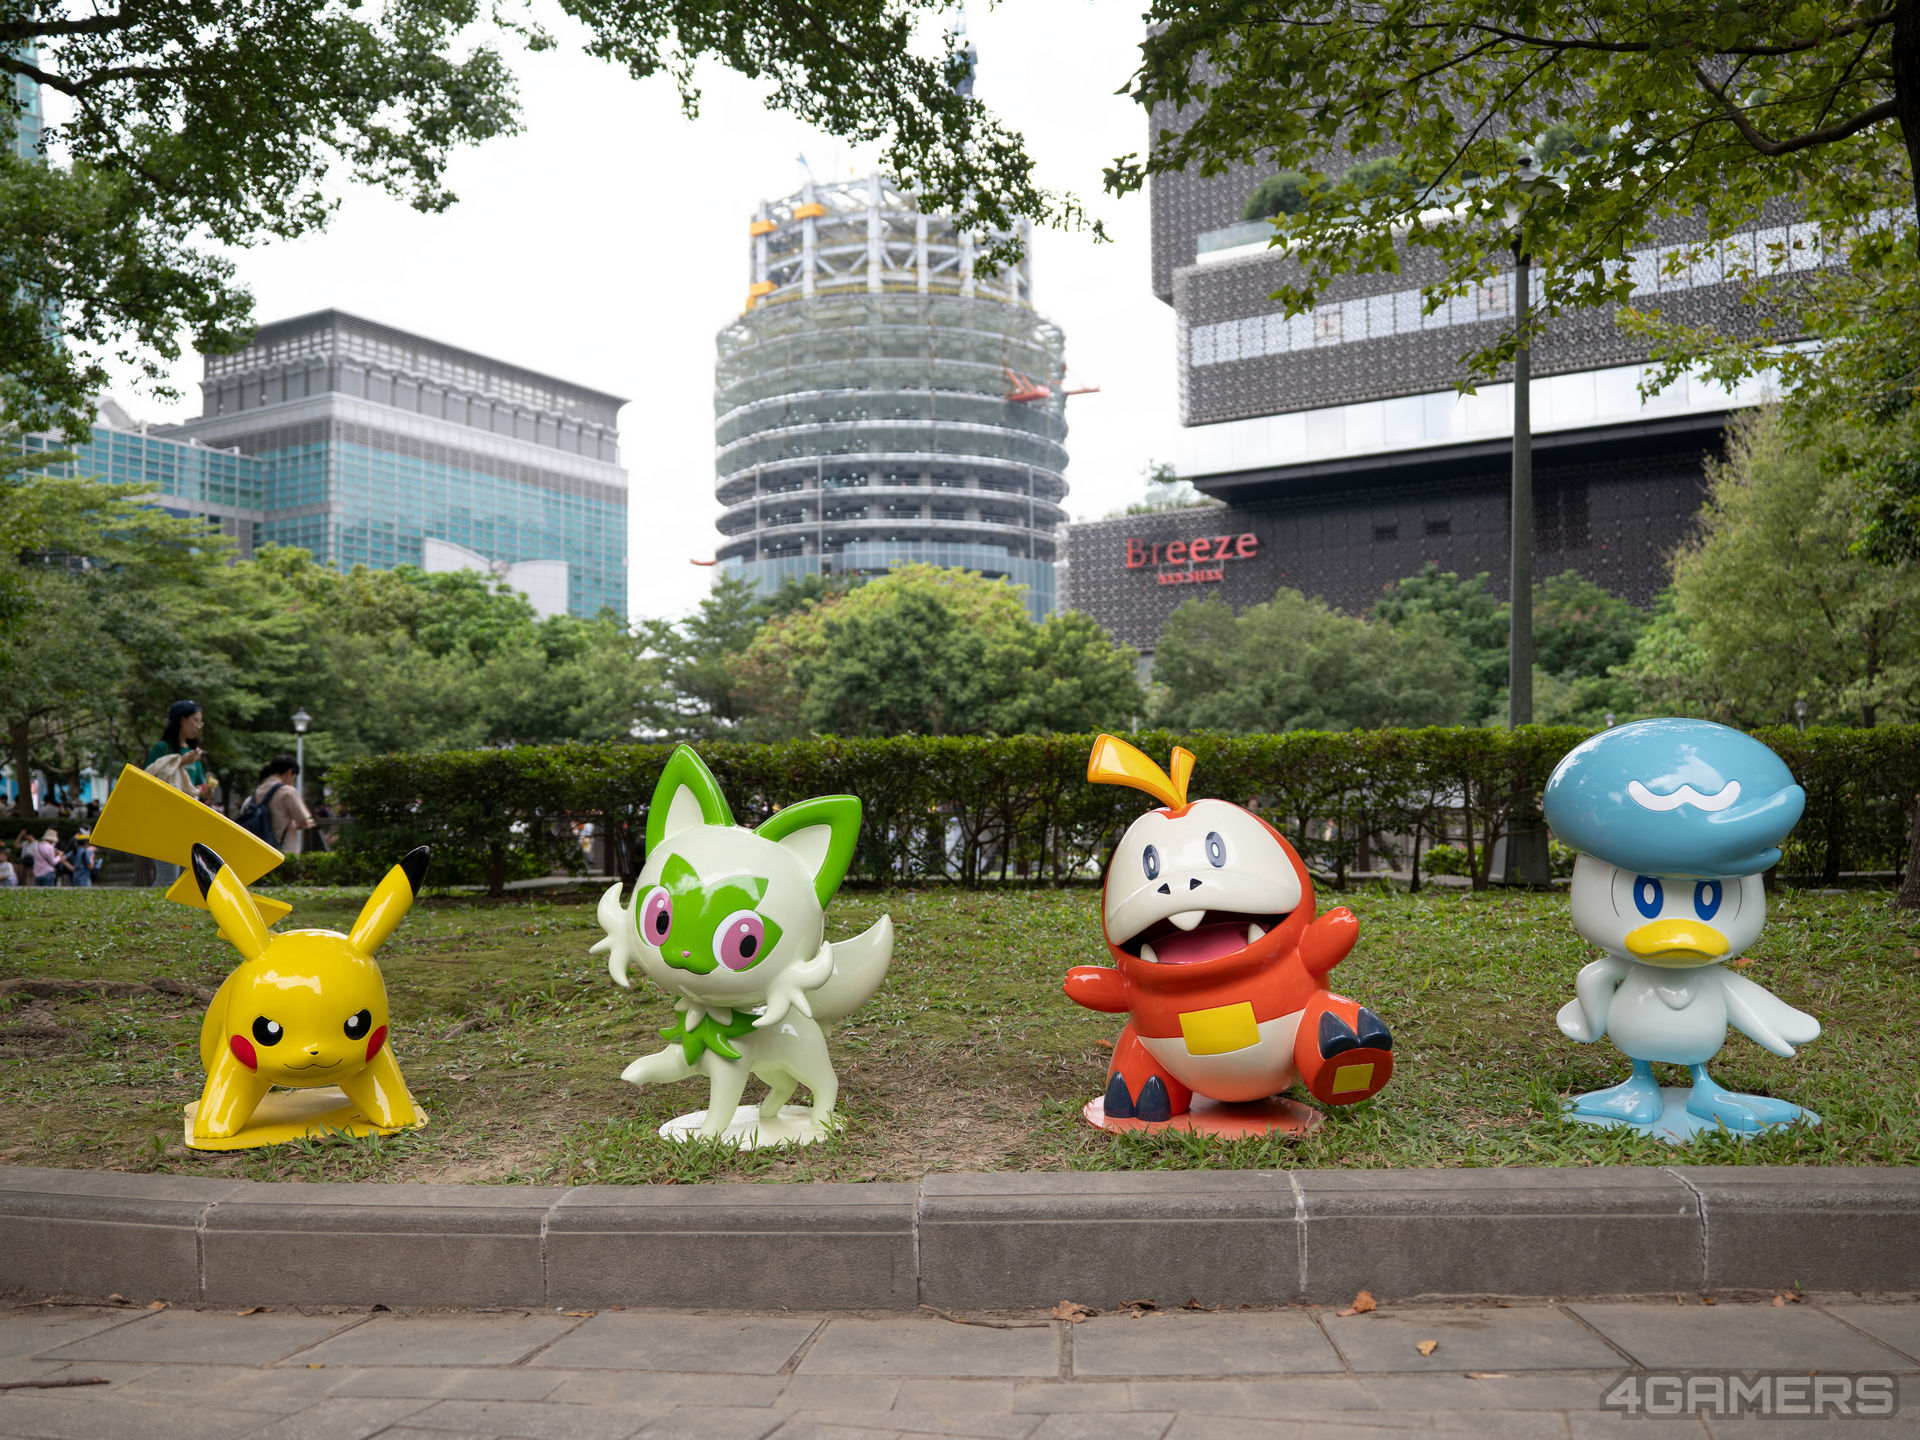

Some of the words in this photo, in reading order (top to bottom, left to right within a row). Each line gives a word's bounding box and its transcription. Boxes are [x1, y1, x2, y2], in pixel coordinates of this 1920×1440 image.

[1126, 533, 1258, 568] Breeze
[1158, 572, 1185, 585] NAN
[1186, 569, 1224, 583] SHAN
